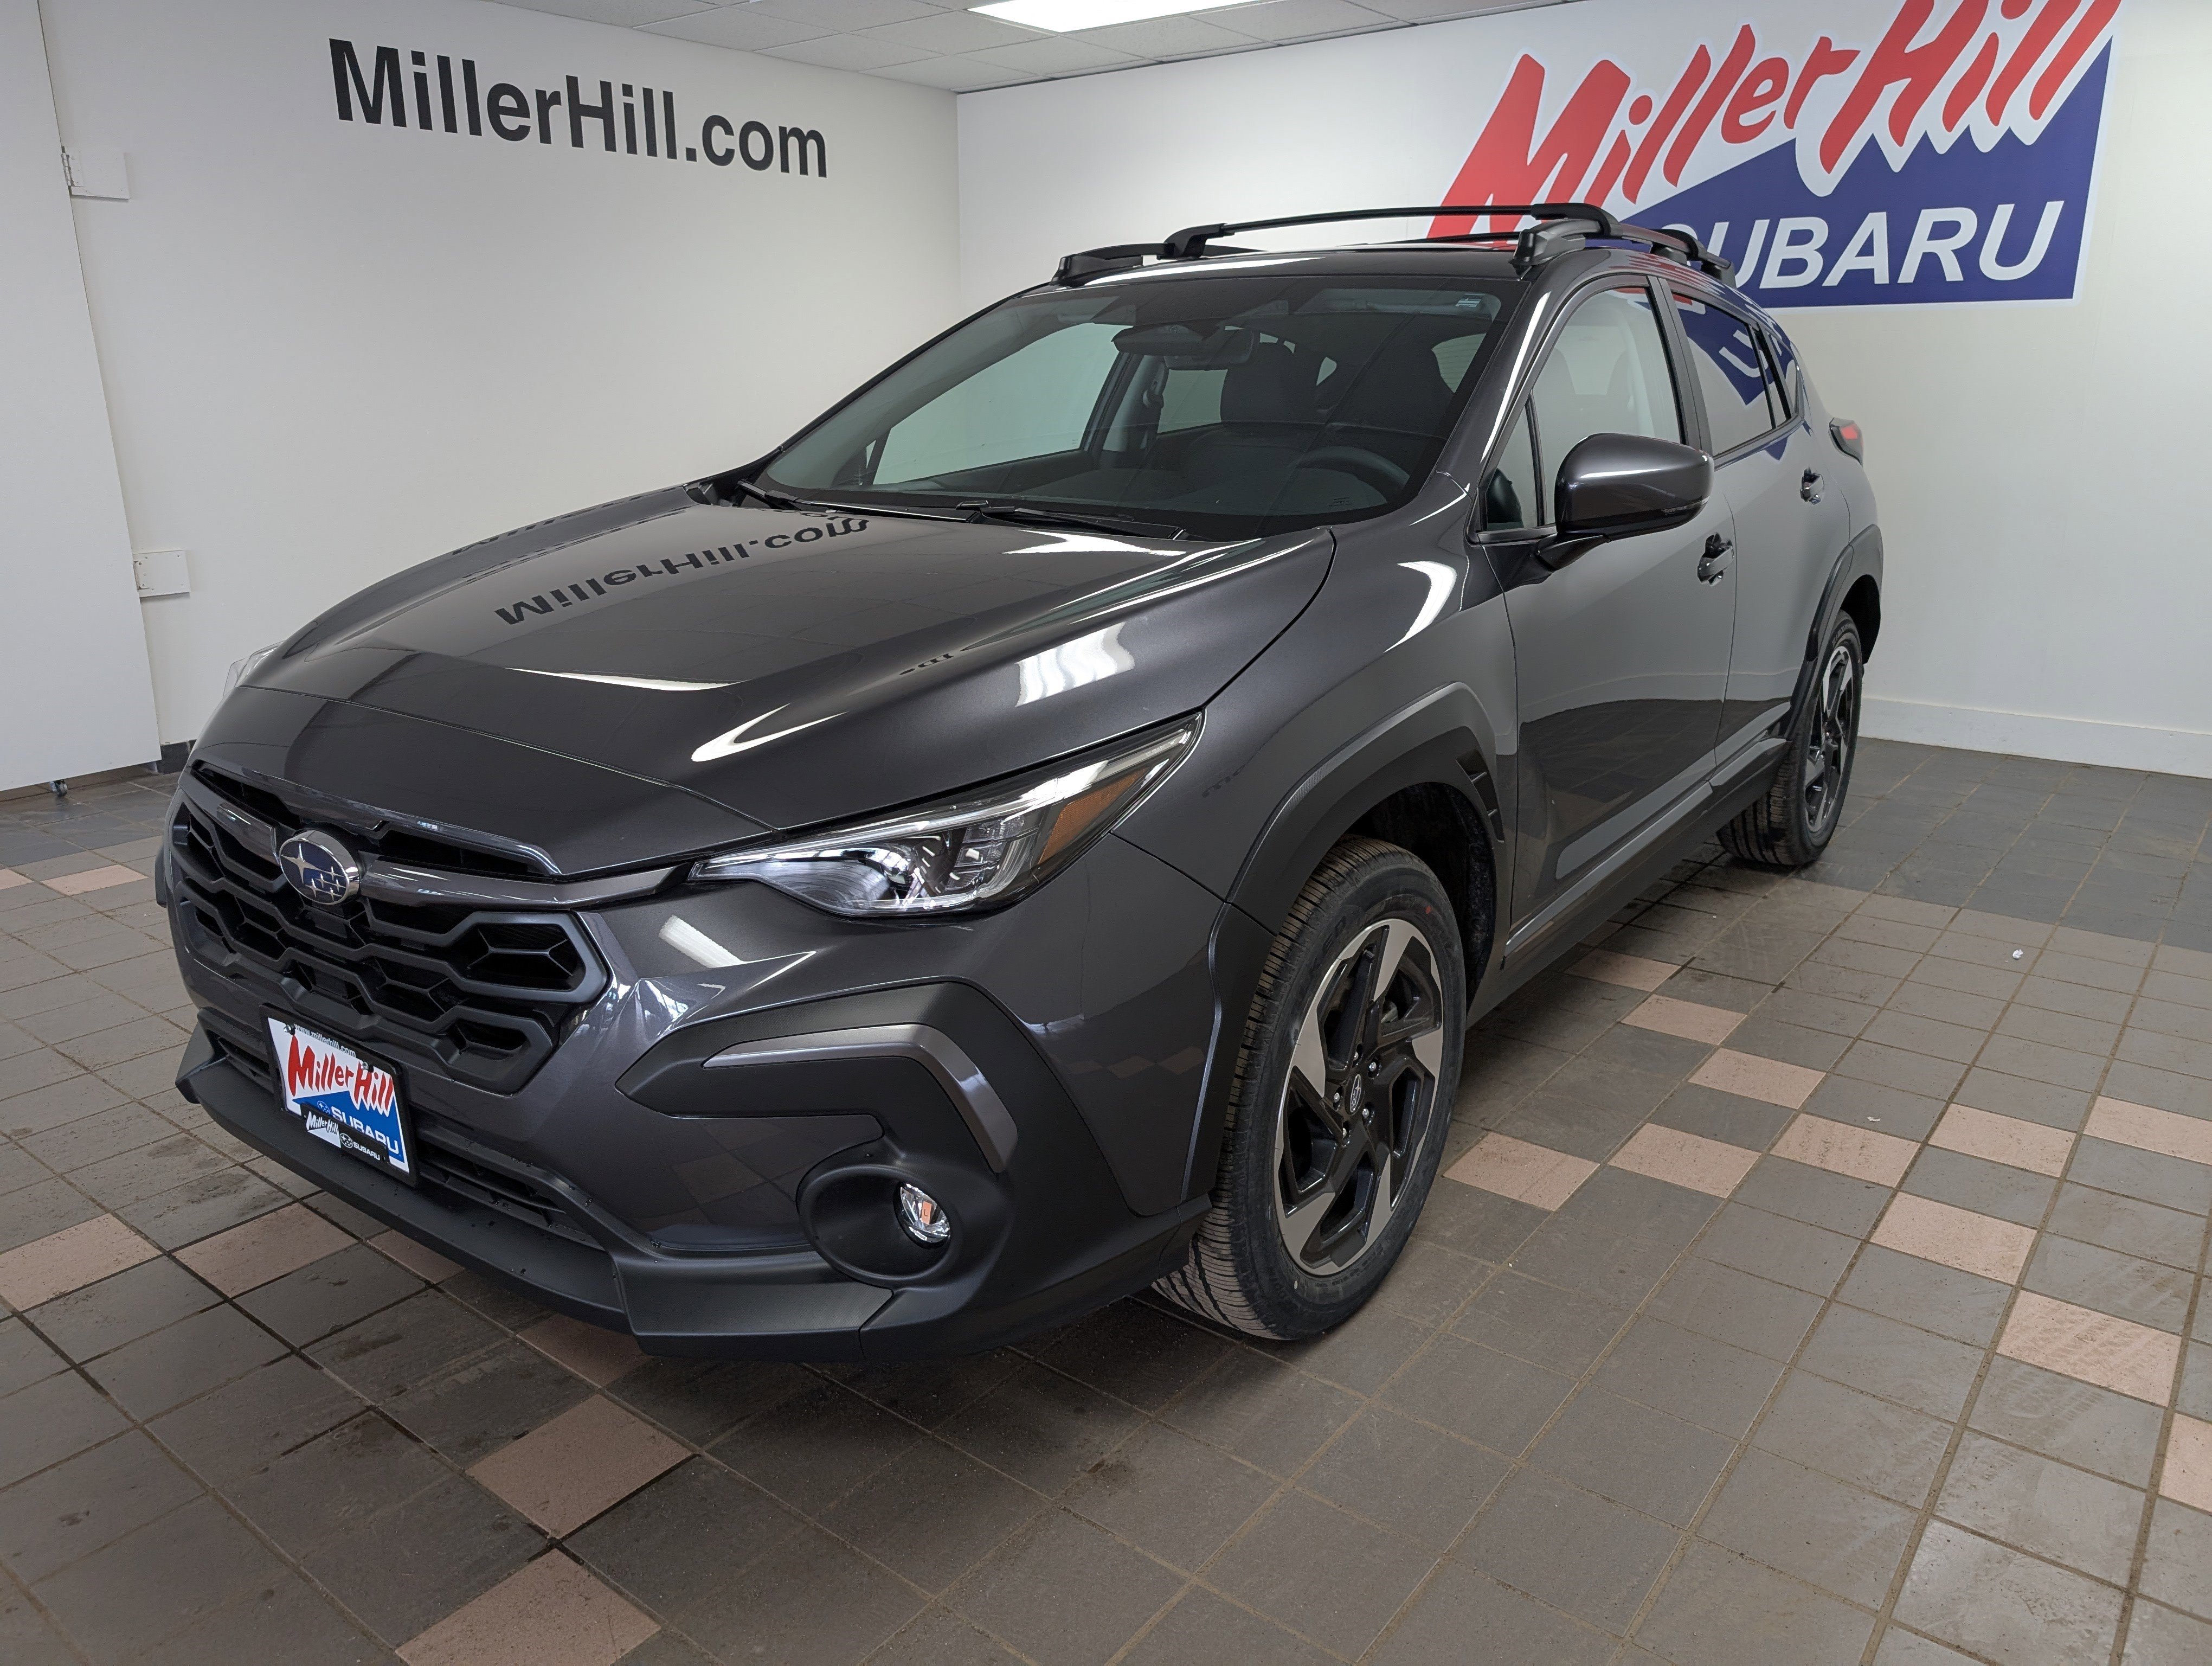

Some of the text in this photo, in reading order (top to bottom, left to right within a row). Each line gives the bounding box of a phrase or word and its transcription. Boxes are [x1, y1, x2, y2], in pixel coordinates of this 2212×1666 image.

[329, 38, 827, 178] MillerHill.com
[1660, 200, 2065, 289] UBARU
[331, 1106, 400, 1154] SUBARU
[353, 1142, 380, 1161] SUBARU
[923, 1209, 928, 1217] L
